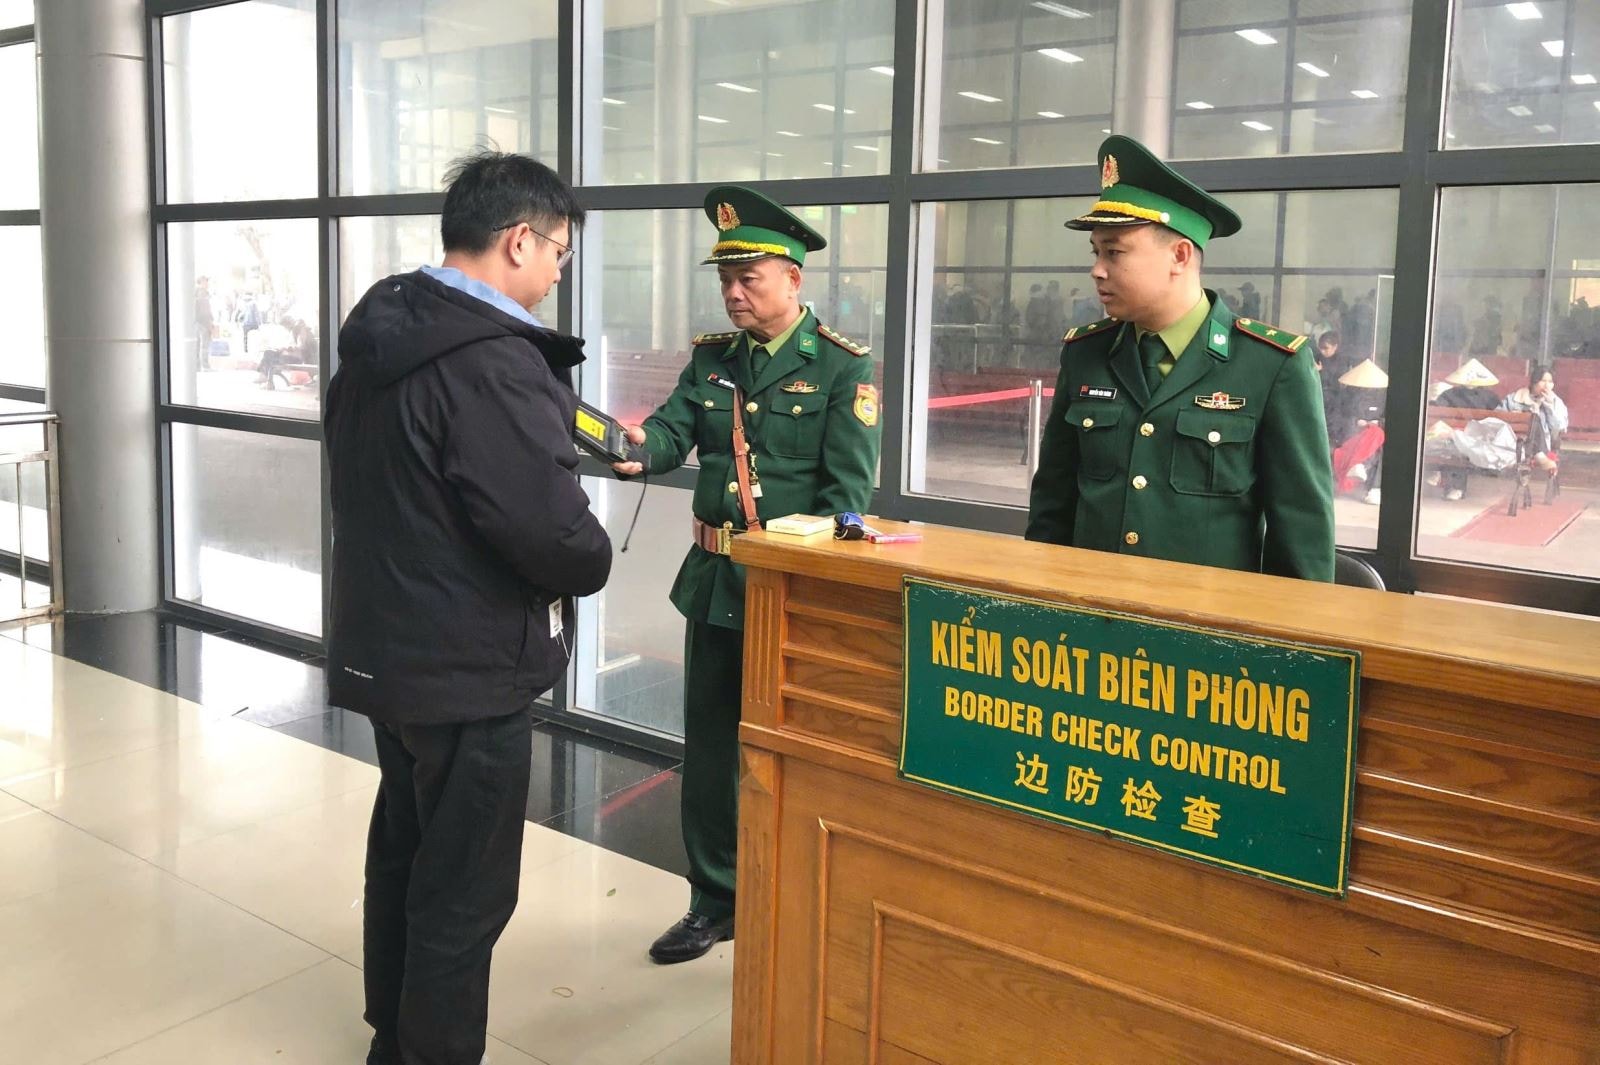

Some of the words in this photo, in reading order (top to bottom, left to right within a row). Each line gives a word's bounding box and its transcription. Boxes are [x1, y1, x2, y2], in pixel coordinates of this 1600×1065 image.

[931, 606, 1002, 678] KIỂM
[1012, 632, 1090, 696] SOÁT
[1099, 647, 1176, 715] BIÊN
[1186, 666, 1311, 743] PHÒNG
[944, 686, 1043, 737] BORDER
[1051, 711, 1142, 761] CHECK
[1150, 733, 1287, 795] CONTROL
[1014, 751, 1222, 839] 边防检查
